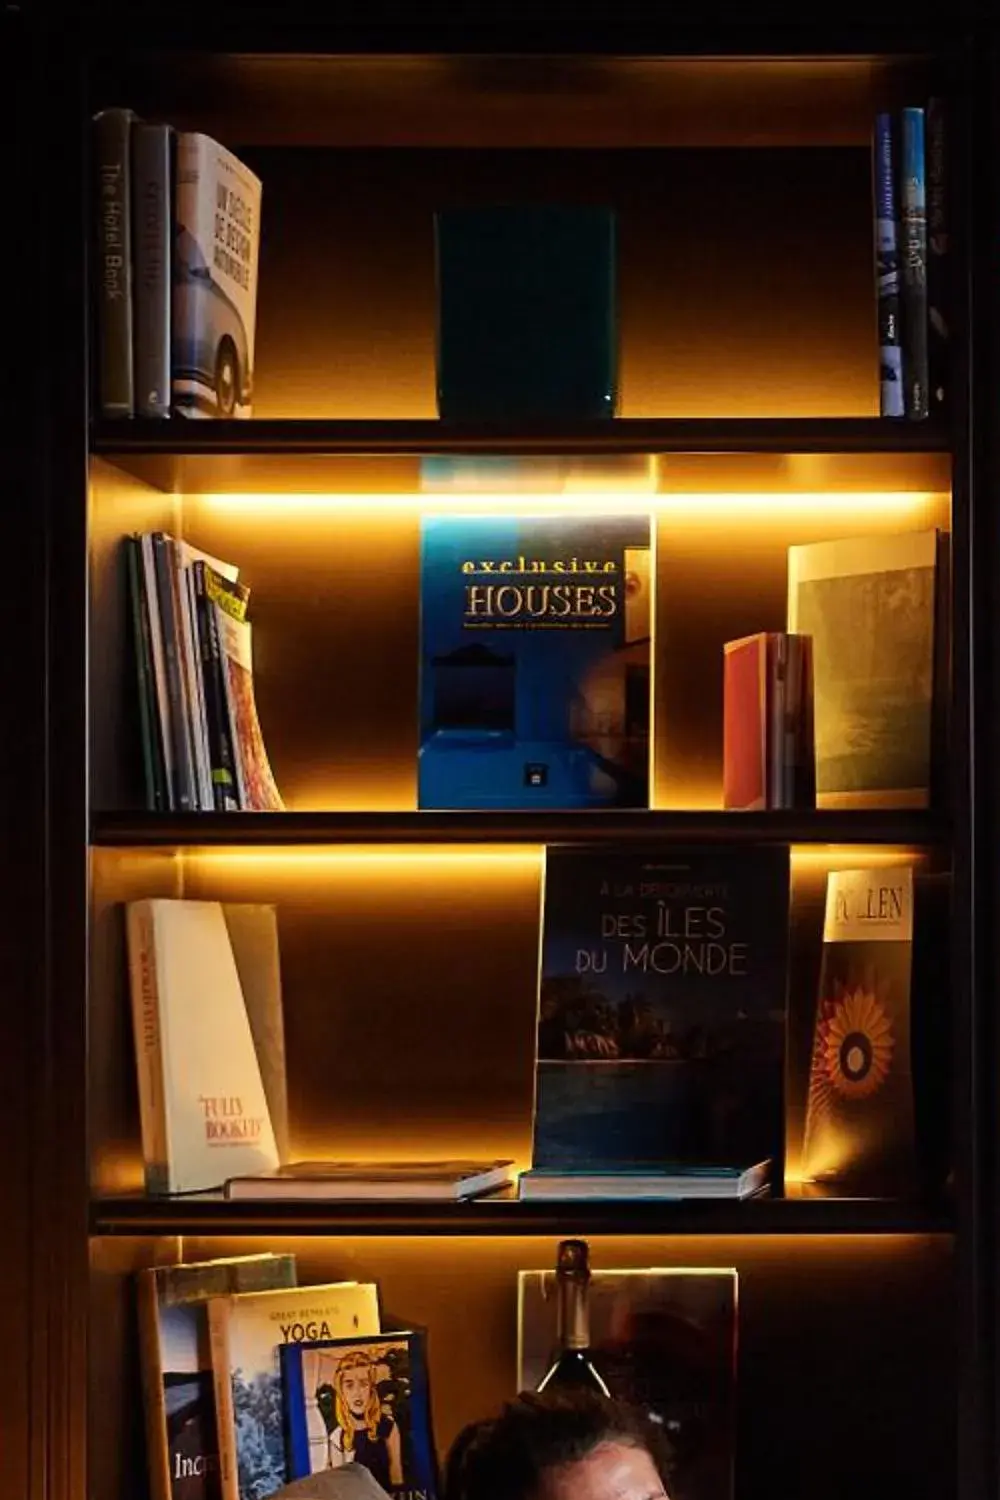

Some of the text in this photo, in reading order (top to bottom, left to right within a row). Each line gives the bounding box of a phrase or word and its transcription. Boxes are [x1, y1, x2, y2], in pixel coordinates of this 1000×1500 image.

[102, 201, 123, 249] Hotel
[462, 556, 616, 575] exclusive
[465, 584, 617, 617] HOUSES
[602, 914, 647, 938] DES
[576, 942, 749, 976] DU MONDE
[280, 1321, 332, 1343] YOGA
